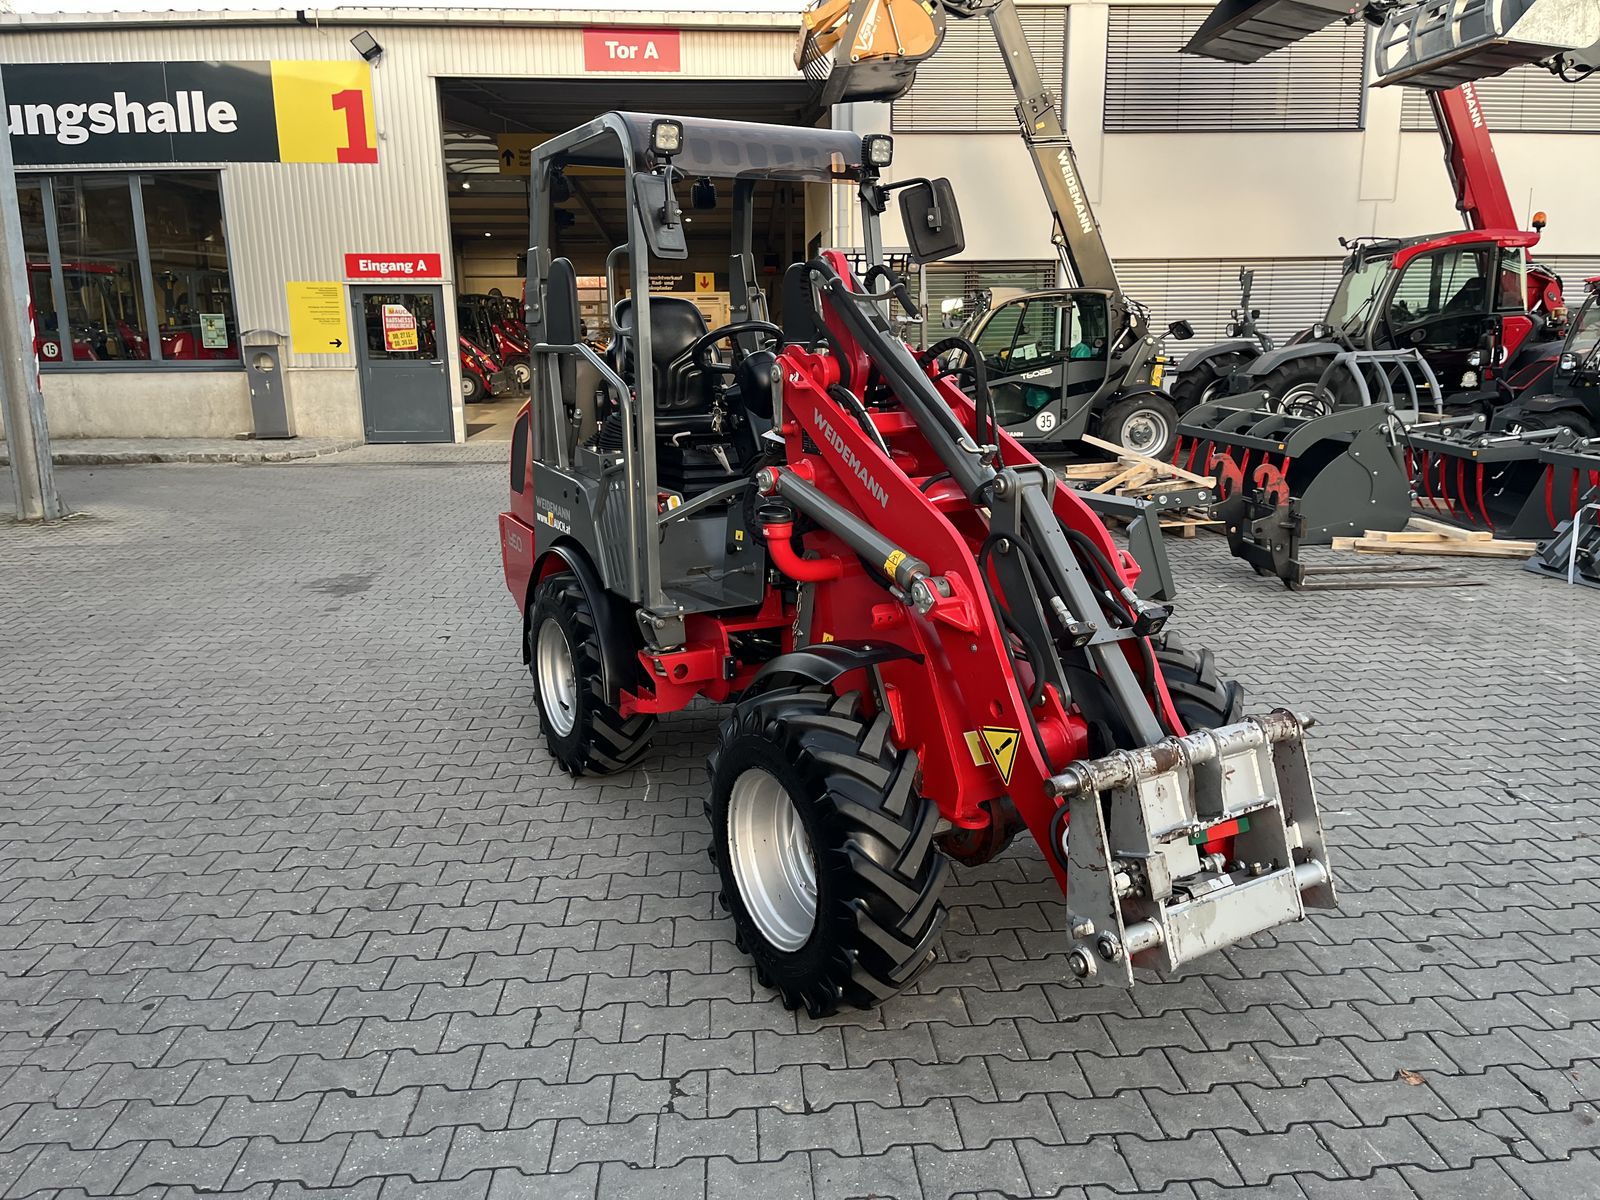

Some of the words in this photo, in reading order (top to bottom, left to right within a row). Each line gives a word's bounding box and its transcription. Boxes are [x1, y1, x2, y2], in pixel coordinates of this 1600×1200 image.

[604, 40, 639, 59] Tor
[643, 41, 660, 59] A
[1461, 81, 1483, 129] EMANN
[331, 89, 379, 164] 1
[1057, 149, 1093, 234] WEIDEMANN
[358, 259, 414, 274] Eingang
[416, 259, 428, 272] A
[45, 344, 56, 355] 15
[1040, 415, 1052, 428] 35
[814, 407, 889, 504] WEIDEMANN
[535, 495, 571, 521] WEIDEMANN
